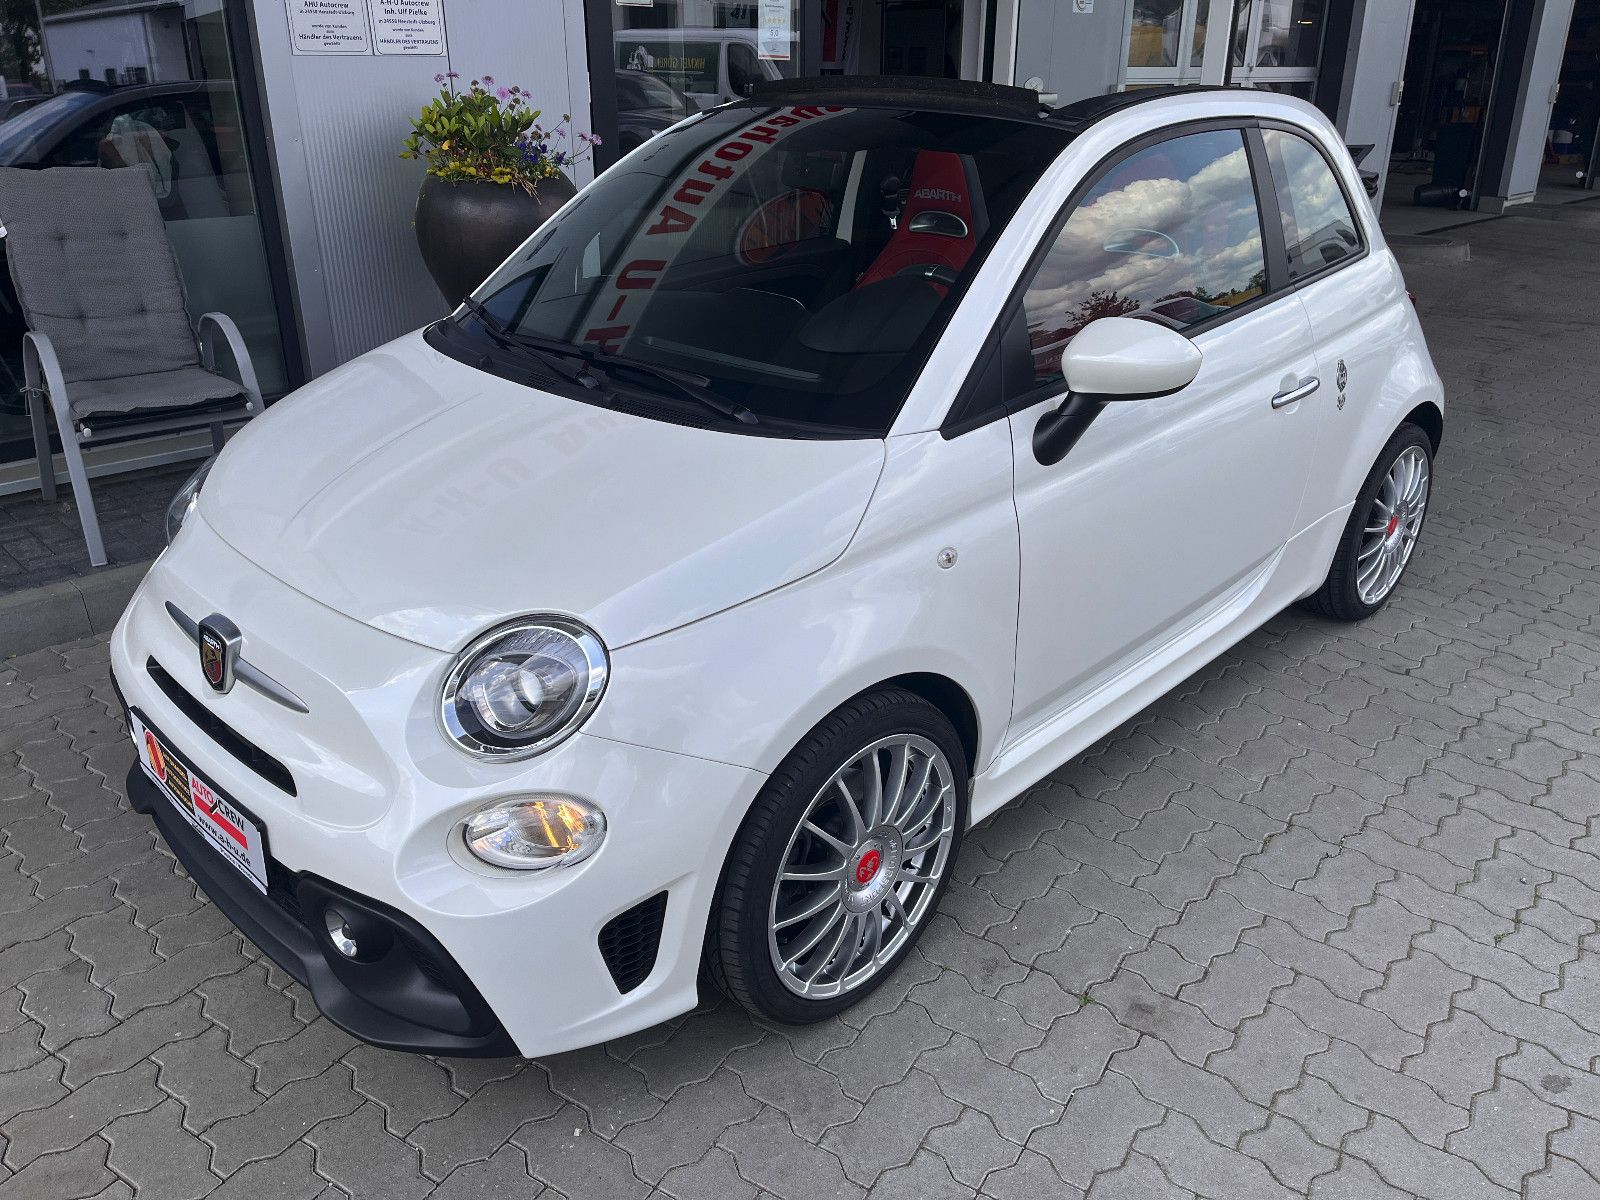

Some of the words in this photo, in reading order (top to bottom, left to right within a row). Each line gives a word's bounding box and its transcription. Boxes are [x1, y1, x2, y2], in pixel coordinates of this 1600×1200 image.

[319, 1, 349, 9] Autocrew
[914, 188, 962, 203] ABARTH
[202, 634, 221, 651] ABARTH
[191, 776, 215, 805] AUTO
[216, 799, 245, 832] CREW
